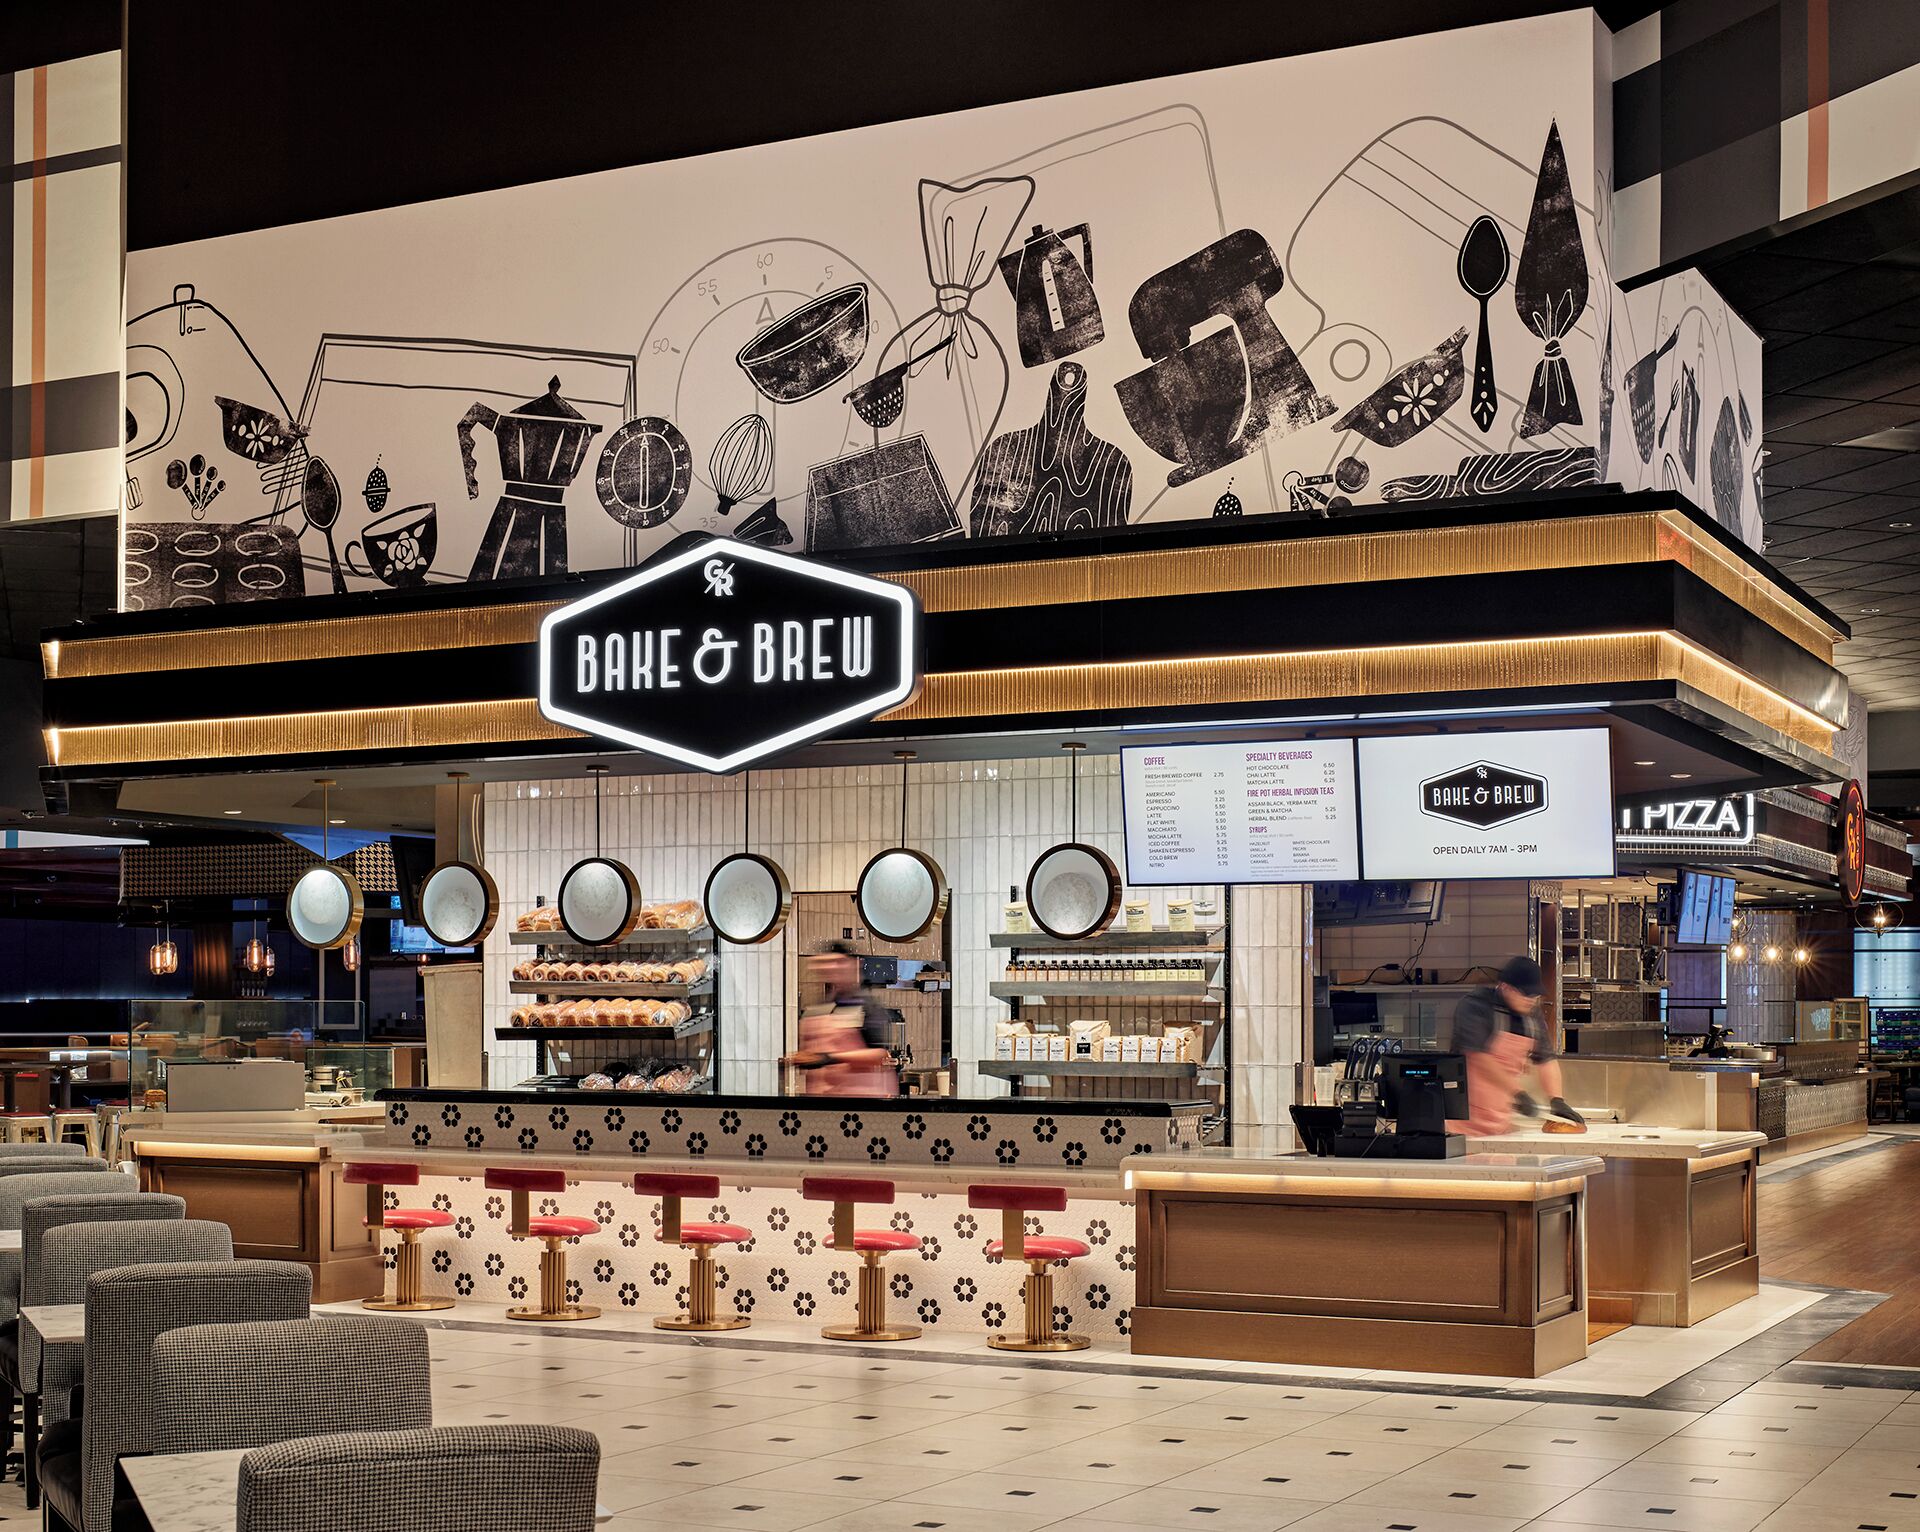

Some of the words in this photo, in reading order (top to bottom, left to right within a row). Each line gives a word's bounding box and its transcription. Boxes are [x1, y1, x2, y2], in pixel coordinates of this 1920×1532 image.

[756, 252, 774, 269] 60
[824, 265, 834, 280] 5
[697, 279, 718, 296] 55
[652, 338, 670, 354] 50
[699, 516, 719, 528] 35
[577, 629, 681, 693] BAKE
[693, 628, 738, 684] &
[753, 616, 872, 683] BREW
[1144, 757, 1165, 765] COFFEE
[1246, 753, 1276, 761] SPECIALTY
[1278, 751, 1313, 760] BEVERAGES
[1433, 787, 1470, 806] BAKE
[1474, 787, 1490, 804] &
[1494, 785, 1535, 804] BREW
[1644, 800, 1740, 832] PIZZA
[1433, 846, 1458, 854] OPEN
[1461, 846, 1486, 854] DAILY
[1489, 845, 1507, 853] 7AM
